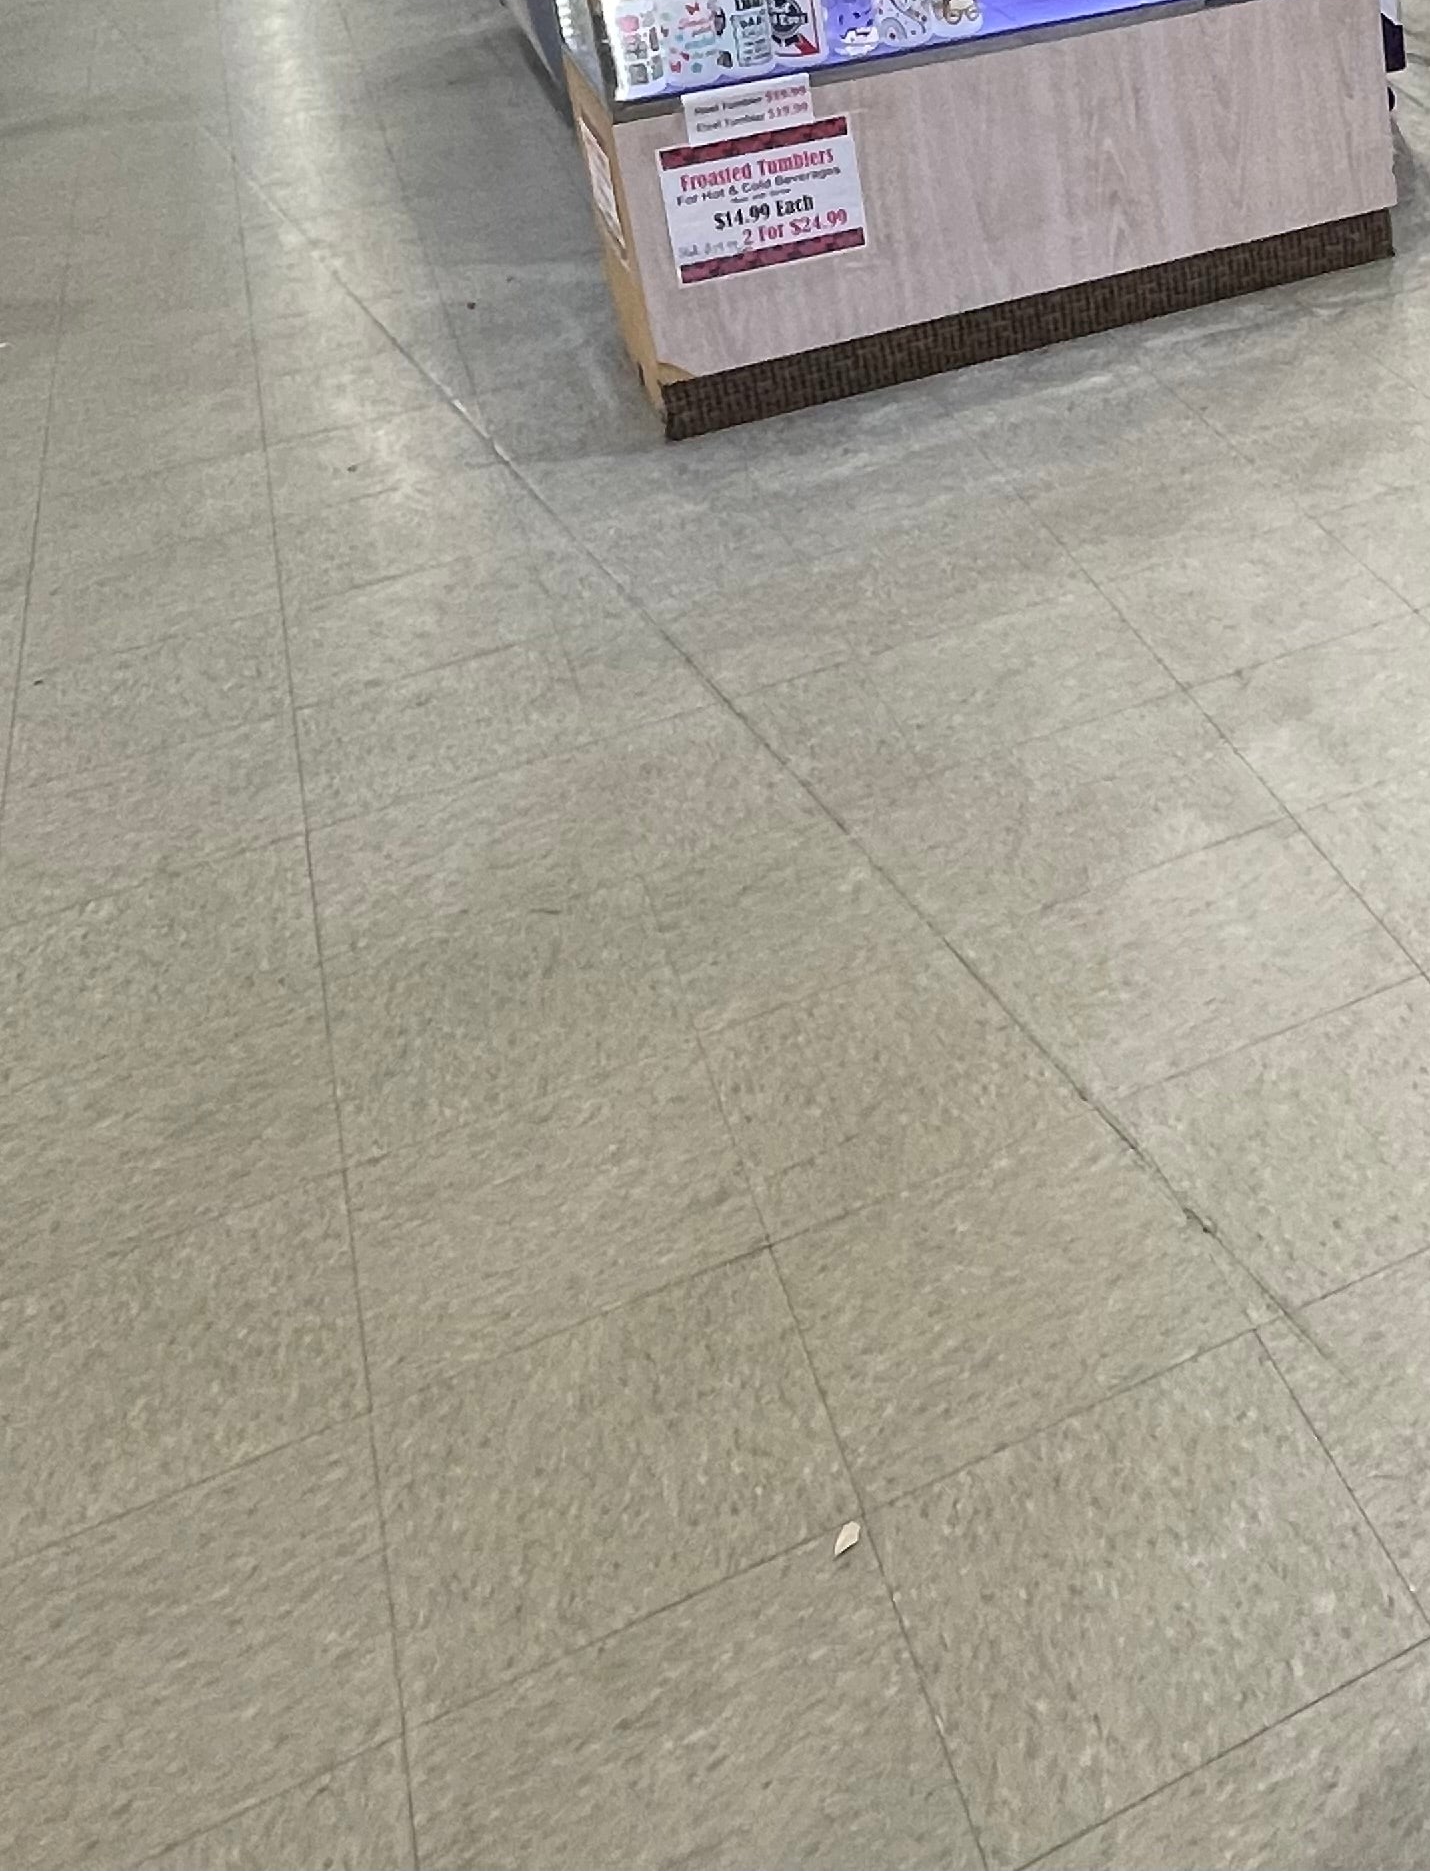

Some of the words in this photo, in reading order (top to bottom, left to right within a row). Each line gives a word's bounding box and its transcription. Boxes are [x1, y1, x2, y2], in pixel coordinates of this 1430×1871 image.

[756, 146, 835, 176] Tumblers
[676, 195, 699, 207] For
[702, 187, 725, 202] Hot
[728, 185, 740, 197] &
[740, 177, 772, 195] Cold
[774, 165, 842, 188] Beverages
[712, 204, 771, 231] $14.99
[775, 194, 815, 218] Each
[742, 228, 754, 247] 2
[789, 208, 849, 236] $24.99
